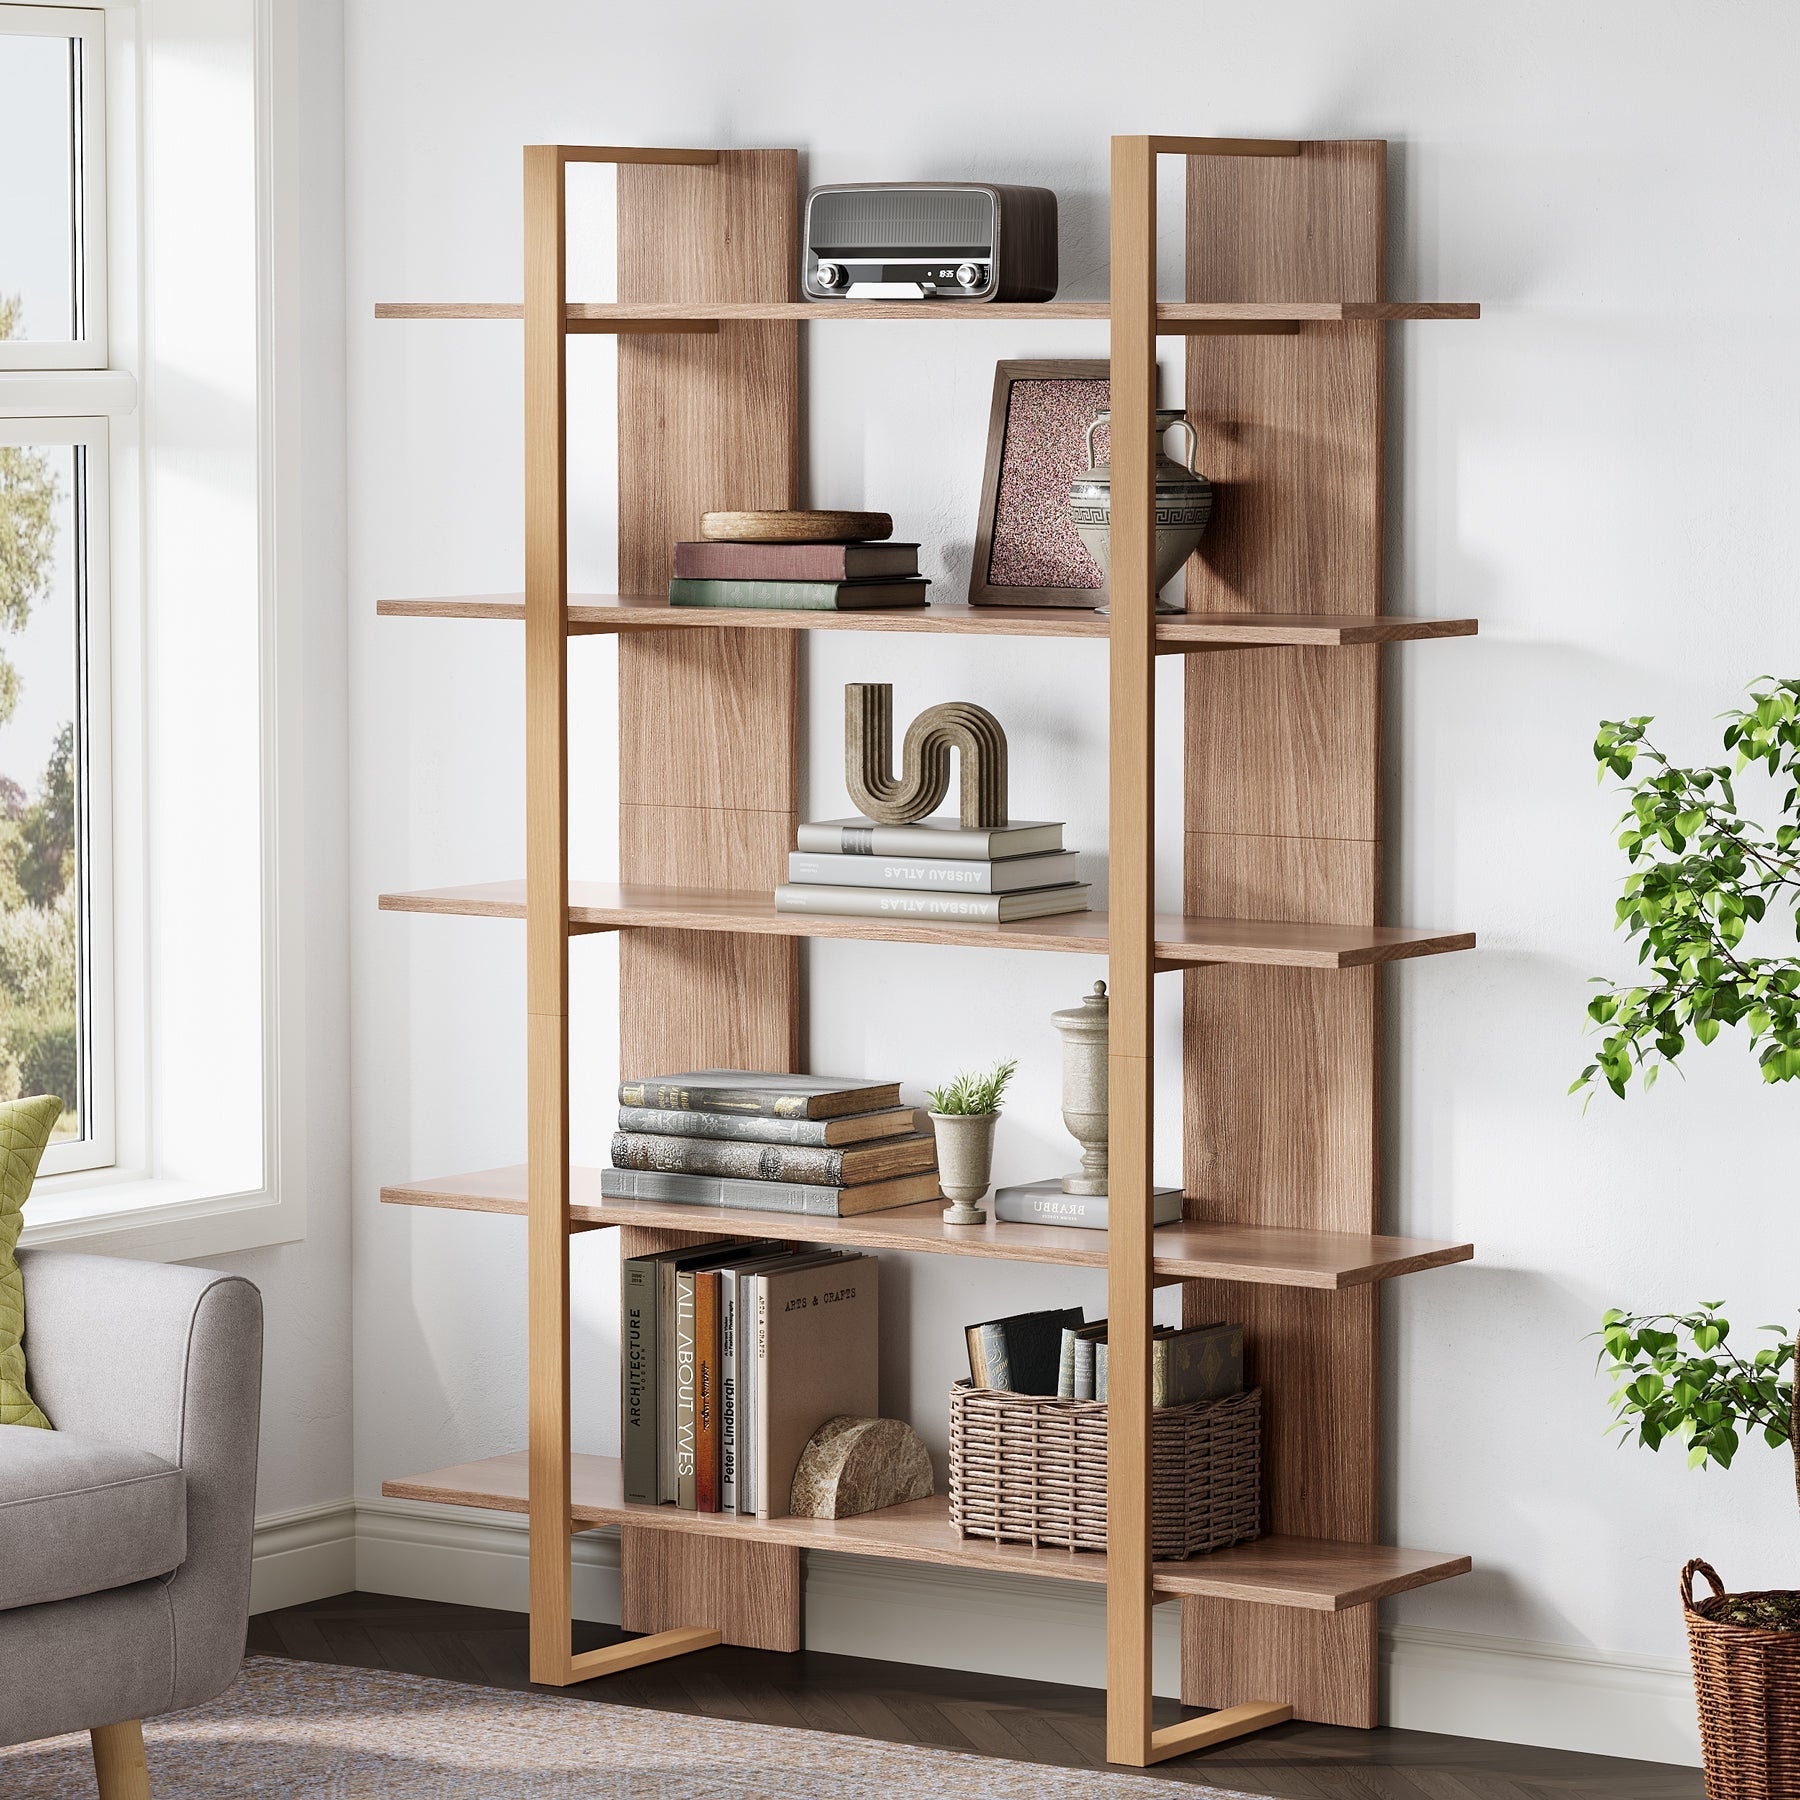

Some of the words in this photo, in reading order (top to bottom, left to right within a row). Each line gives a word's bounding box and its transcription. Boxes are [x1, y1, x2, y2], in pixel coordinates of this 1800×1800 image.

[884, 866, 924, 881] ATLAS
[929, 868, 982, 883] AUSBAU
[880, 898, 924, 912] ATLAS
[929, 901, 989, 916] AUSBAU
[678, 1283, 694, 1325] ALL
[785, 1296, 807, 1312] ARTS
[812, 1296, 819, 1307] &
[823, 1287, 857, 1304] CRAFTS
[629, 1308, 641, 1427] ARCHITECTURE
[678, 1331, 694, 1412] ABOUT
[723, 1378, 735, 1446] Lindbergh
[678, 1421, 694, 1476] YVES
[723, 1449, 735, 1484] Peter
